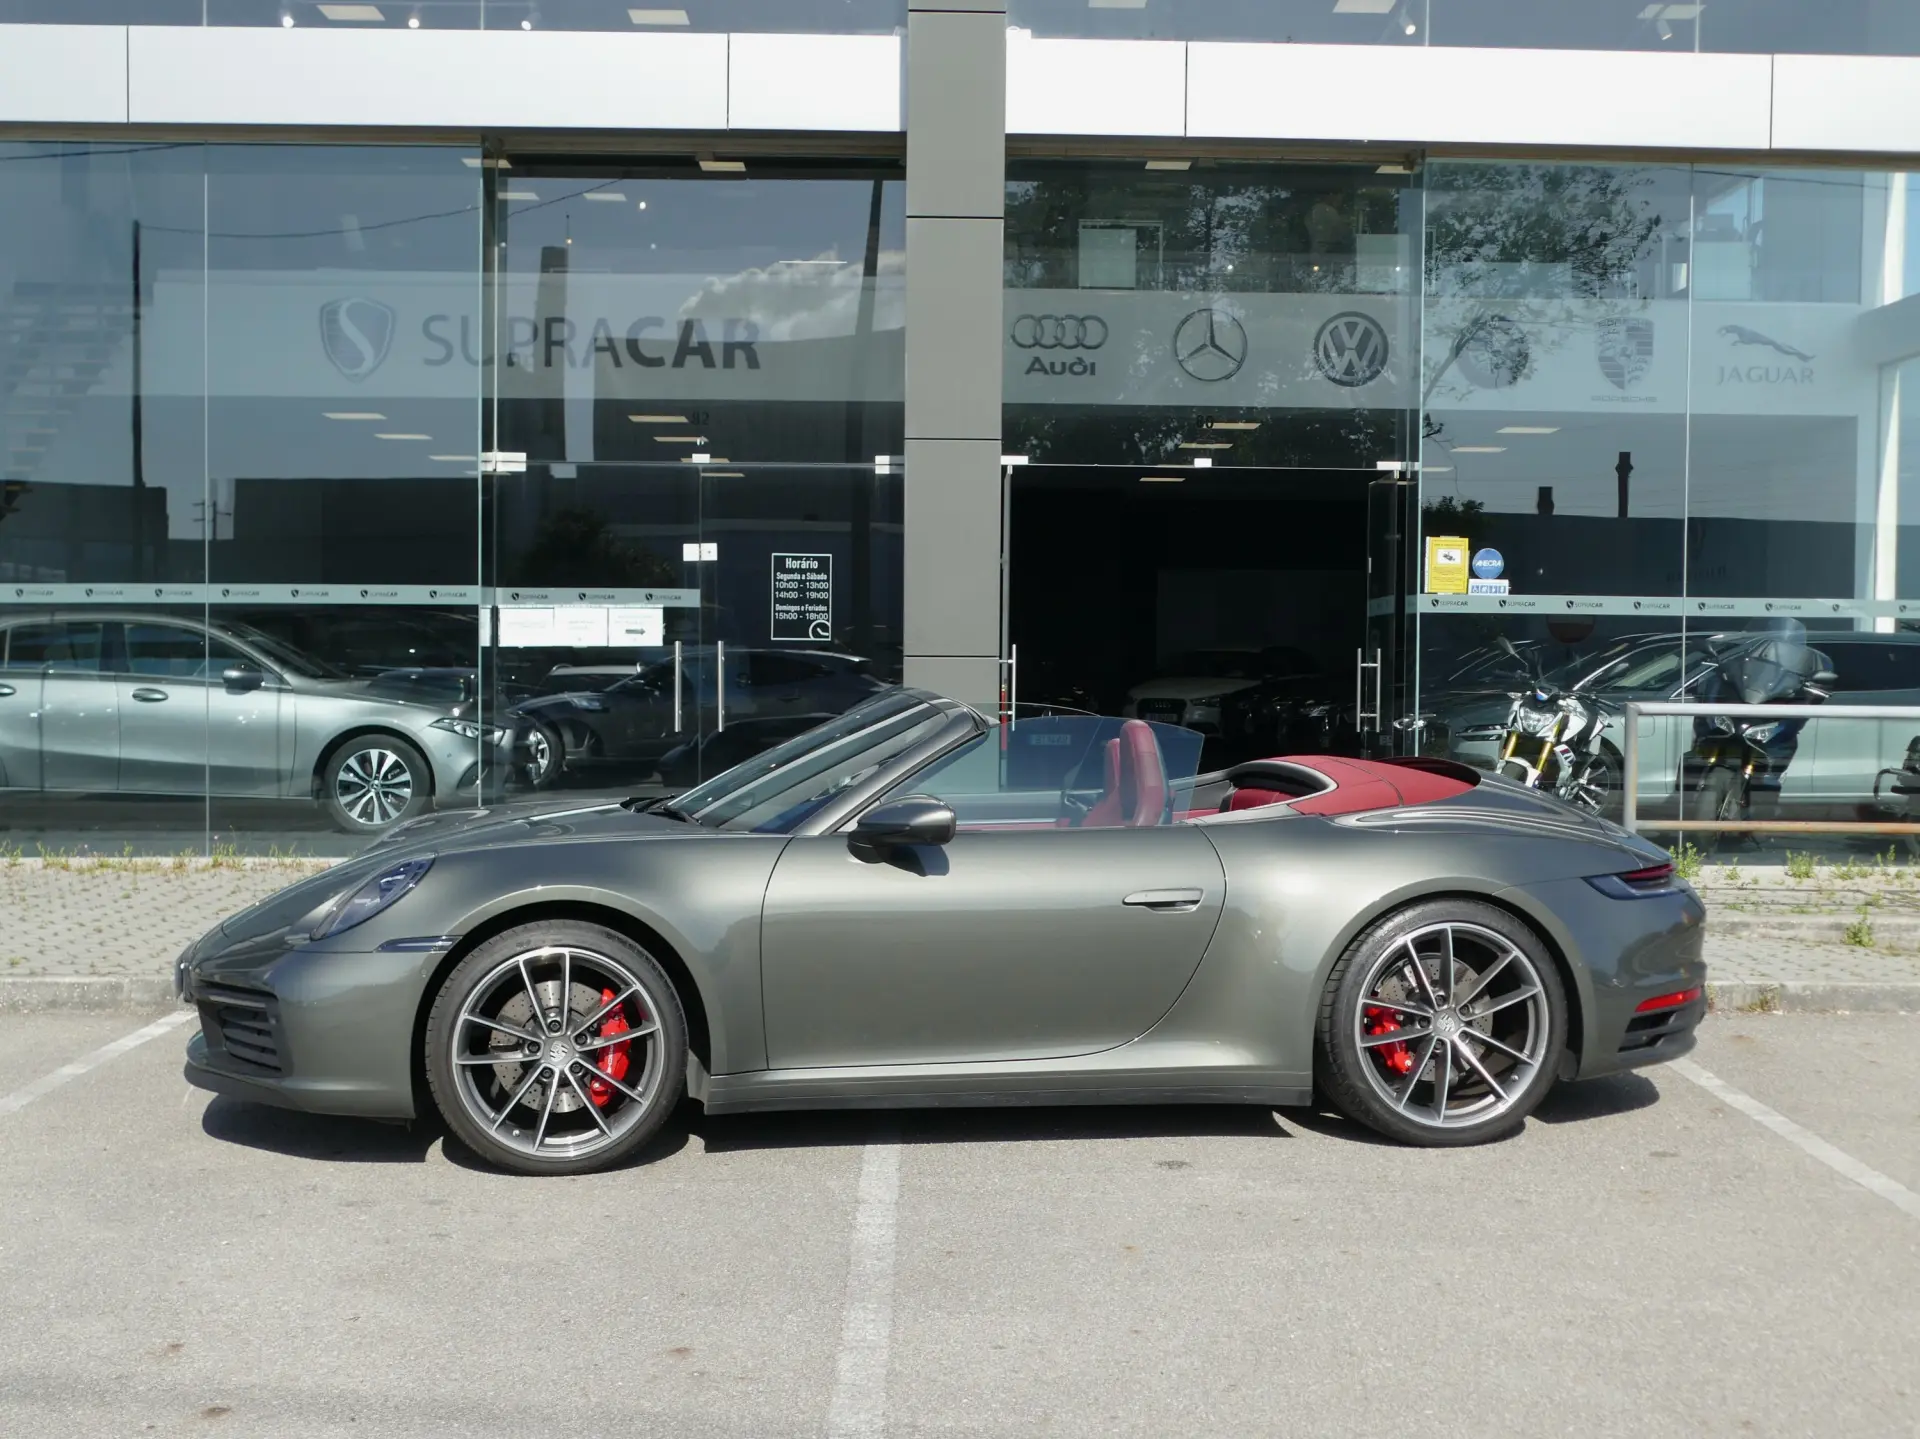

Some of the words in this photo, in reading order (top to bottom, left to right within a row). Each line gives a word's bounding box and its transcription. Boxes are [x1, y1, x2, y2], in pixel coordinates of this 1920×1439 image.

[421, 314, 761, 370] SUPRACAR
[1024, 356, 1096, 376] Audi
[1716, 365, 1814, 386] JAGUAR
[785, 557, 819, 569] Horário
[776, 571, 801, 581] Segunda
[806, 572, 828, 580] Sábado
[775, 581, 798, 589] 10h00
[805, 581, 829, 589] 13h00
[775, 591, 798, 599] 14h00
[805, 591, 829, 599] 19h00
[775, 604, 800, 612] Domingos
[775, 612, 798, 620] 15h00
[805, 612, 829, 620] 18h00
